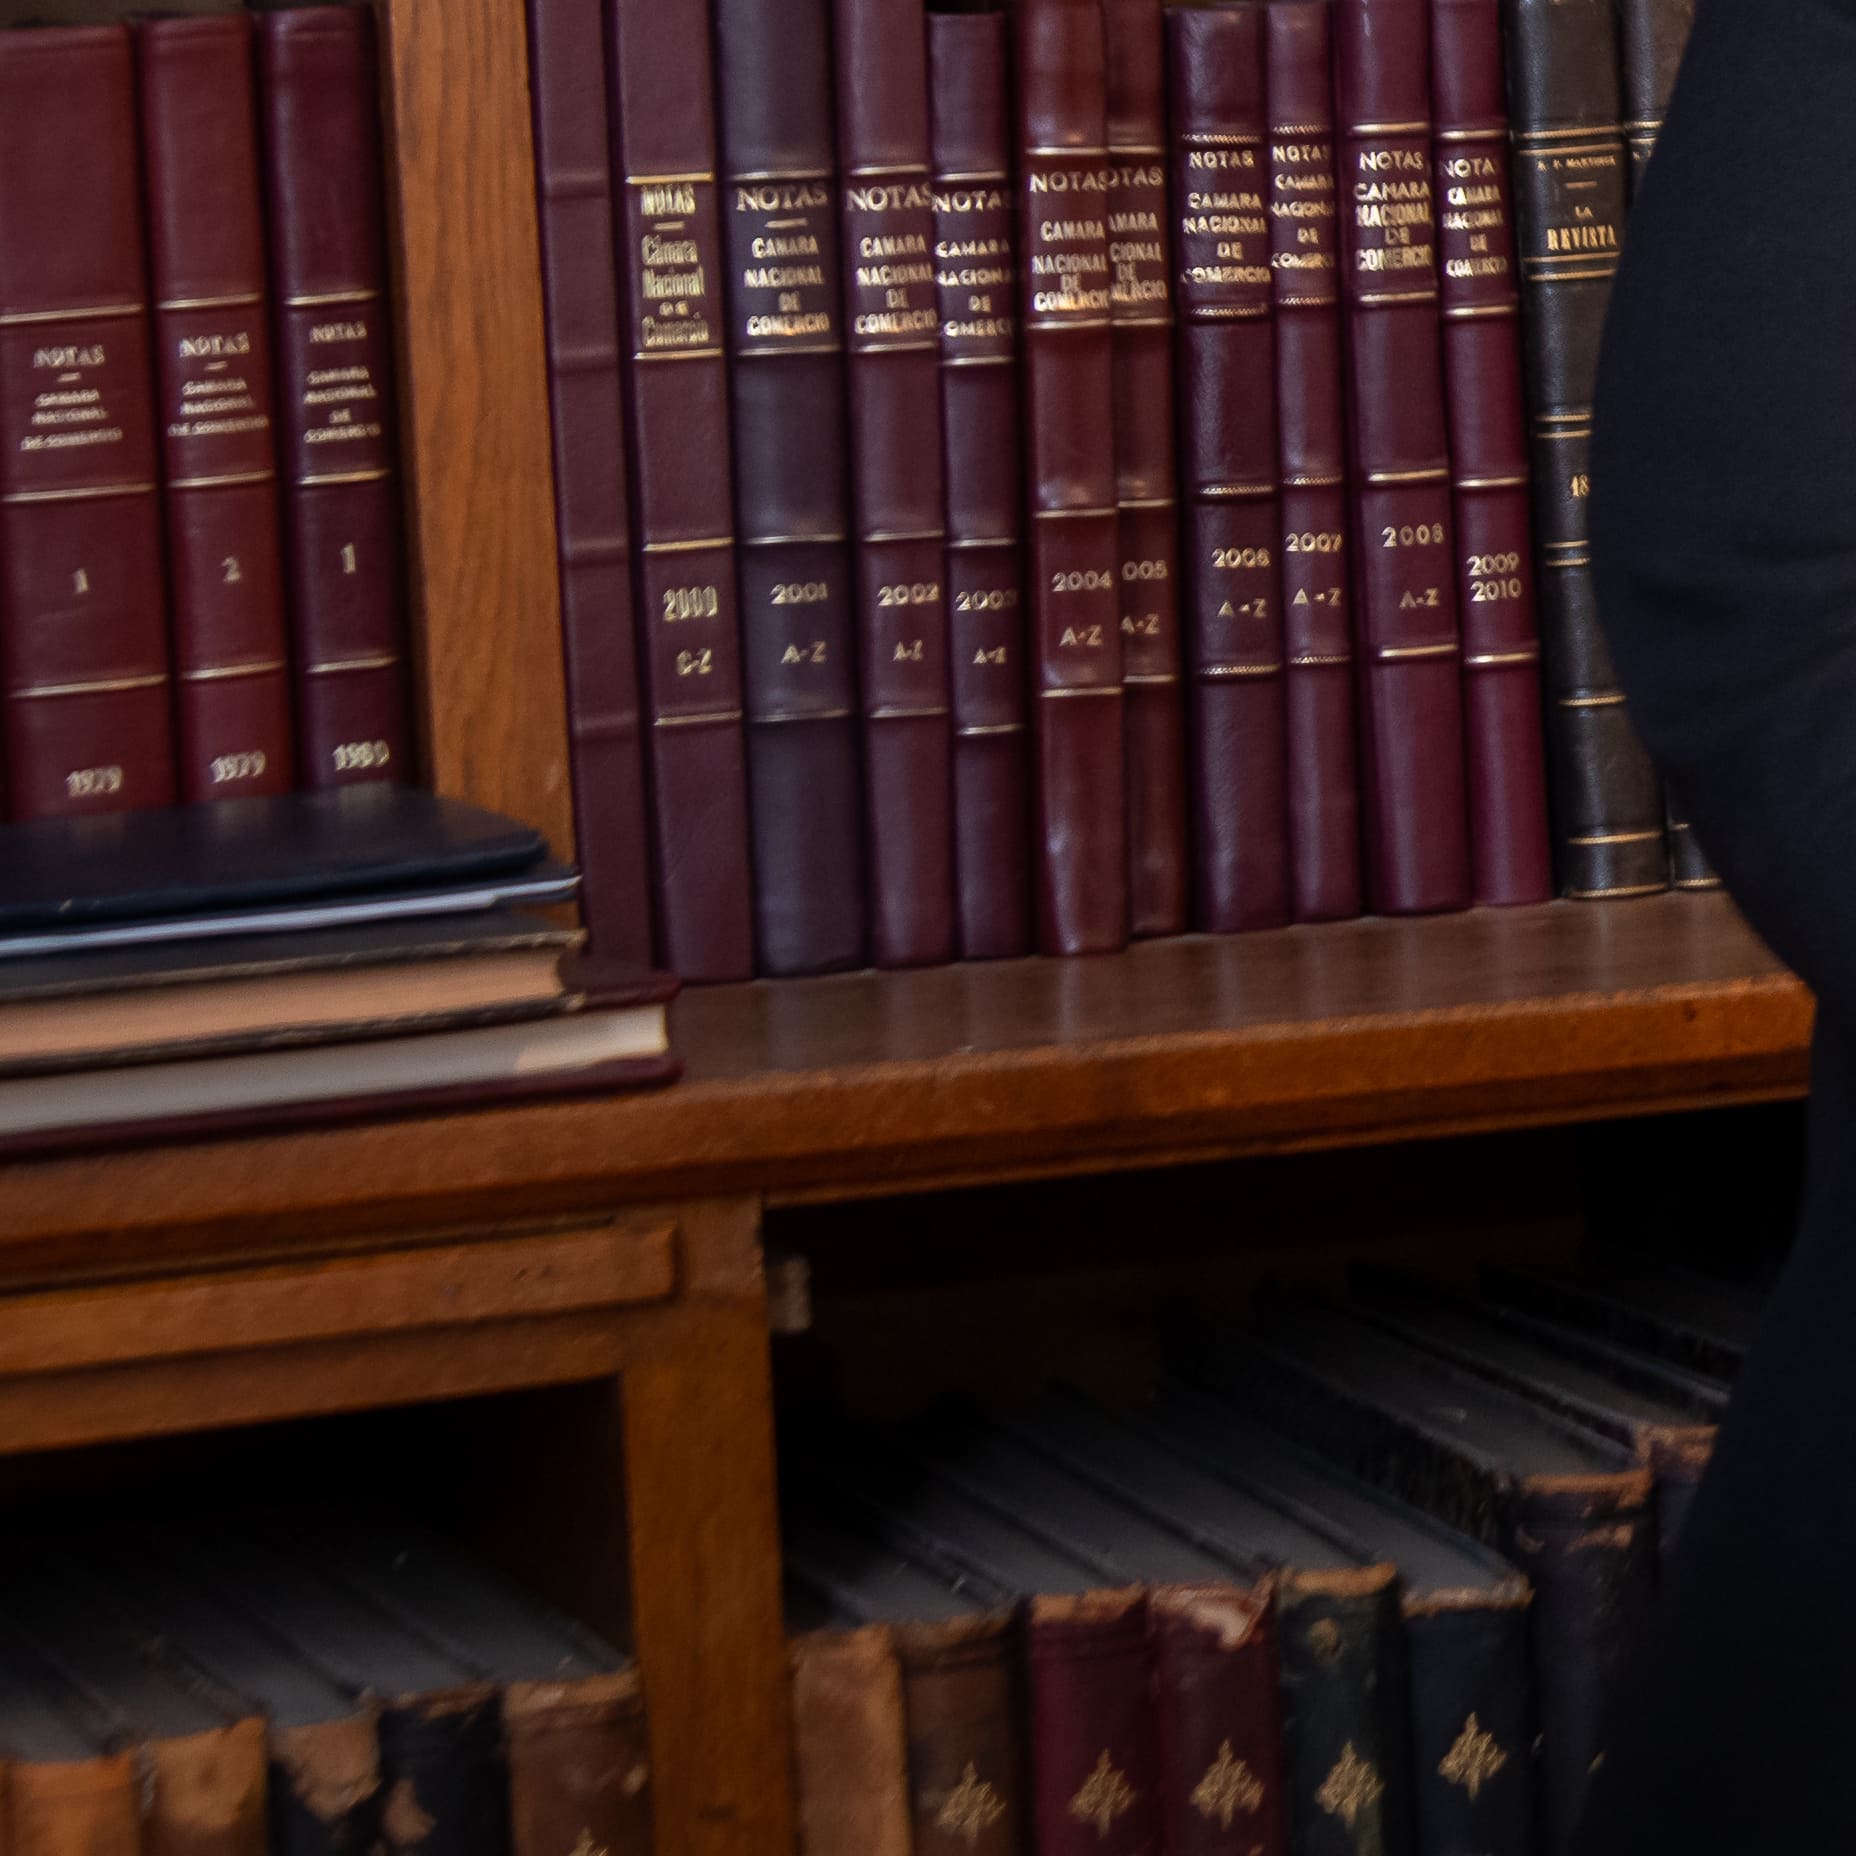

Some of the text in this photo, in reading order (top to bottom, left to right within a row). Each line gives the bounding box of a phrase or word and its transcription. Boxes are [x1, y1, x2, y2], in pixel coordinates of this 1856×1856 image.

[1189, 150, 1254, 168] NOTAS
[1359, 151, 1423, 171] NOTAS
[736, 186, 828, 212] NOTAS
[846, 185, 932, 211] NOTAS
[1187, 191, 1262, 209] CAMARA
[1354, 181, 1430, 201] CAMARA
[1355, 202, 1430, 227] NACIONAL
[1575, 206, 1594, 219] LA
[1041, 220, 1105, 241] CAMARA
[1182, 216, 1267, 234] NACIONAL
[1297, 228, 1319, 243] DE
[752, 236, 819, 258] CAMARA
[860, 235, 926, 257] CAMARA
[1547, 224, 1616, 251] REVISTA
[1216, 241, 1243, 258] DE
[744, 265, 824, 287] NACIONAL
[1061, 274, 1081, 291] DE
[779, 291, 801, 311] DE
[886, 289, 907, 308] DE
[969, 295, 991, 312] DE
[309, 321, 366, 342] NOTAS
[747, 312, 829, 336] COMERCIO
[854, 309, 937, 335] COMERCIO
[180, 333, 250, 357] NOTAS
[34, 346, 105, 369] NOTAS
[1381, 523, 1443, 547] 2008
[341, 543, 356, 574] 1
[1466, 553, 1520, 576] 2009
[74, 569, 88, 593] 1
[223, 558, 241, 583] 2
[1052, 570, 1112, 592] 2004
[771, 583, 828, 605] 2001
[878, 583, 939, 606] 2002
[1471, 578, 1521, 603] 2010
[211, 752, 266, 782] 1979
[68, 766, 122, 796] 1979
